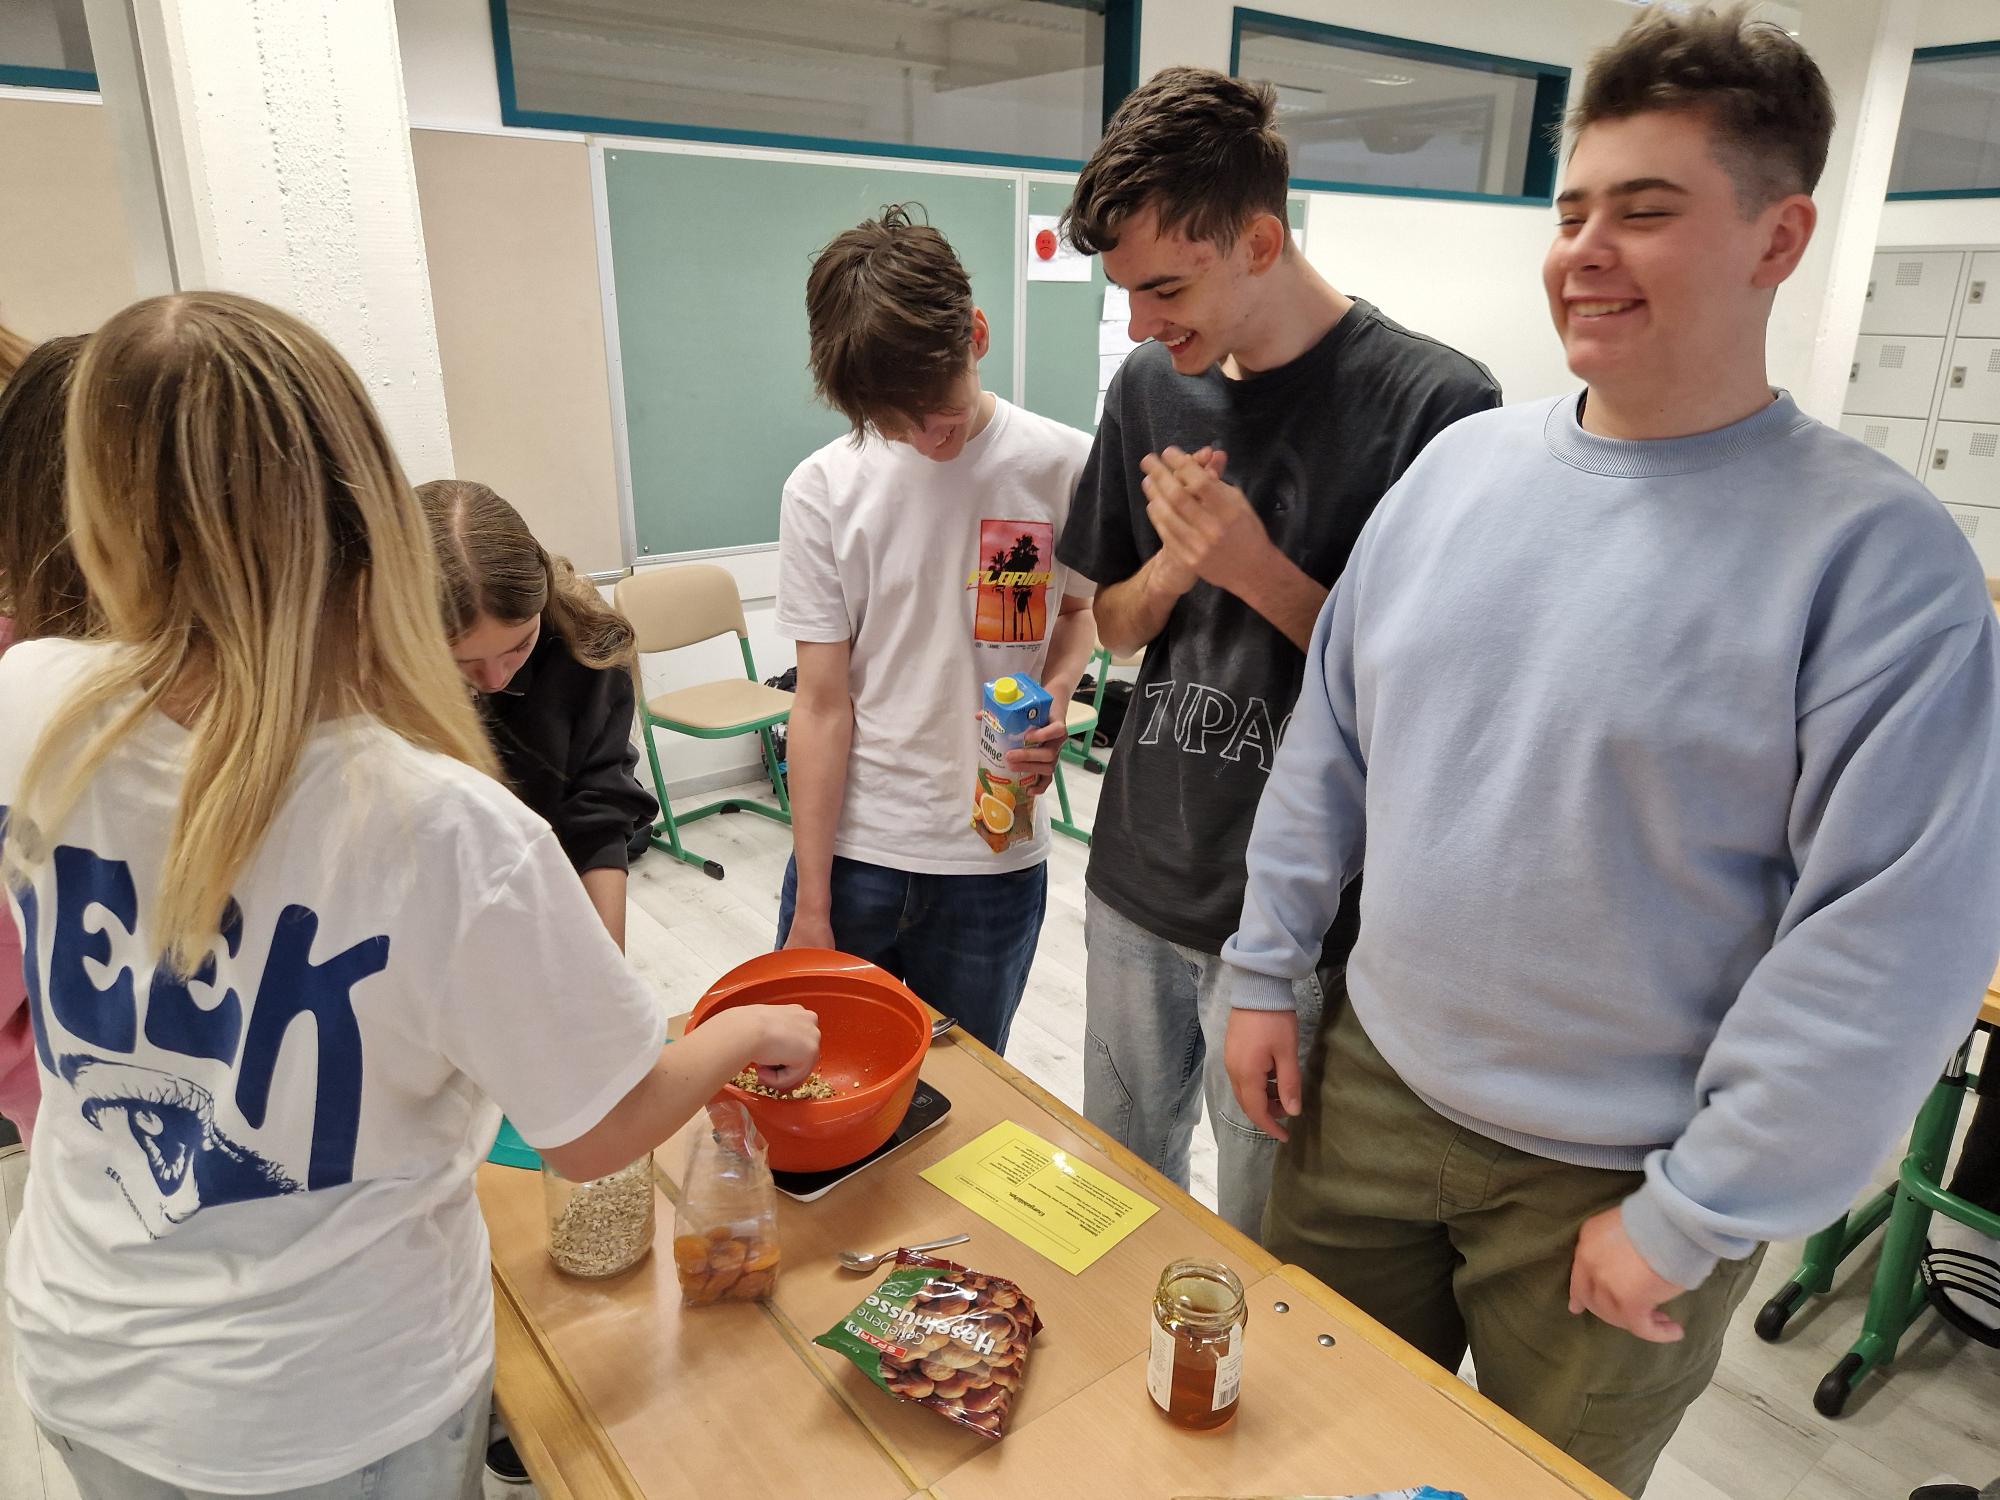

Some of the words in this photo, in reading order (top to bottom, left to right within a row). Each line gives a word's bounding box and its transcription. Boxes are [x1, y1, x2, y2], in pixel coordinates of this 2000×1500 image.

[965, 570, 1056, 586] FLORIDA
[1138, 680, 1293, 773] TPA
[860, 1332, 898, 1355] SPAR
[865, 1295, 996, 1356] Haselnüsse
